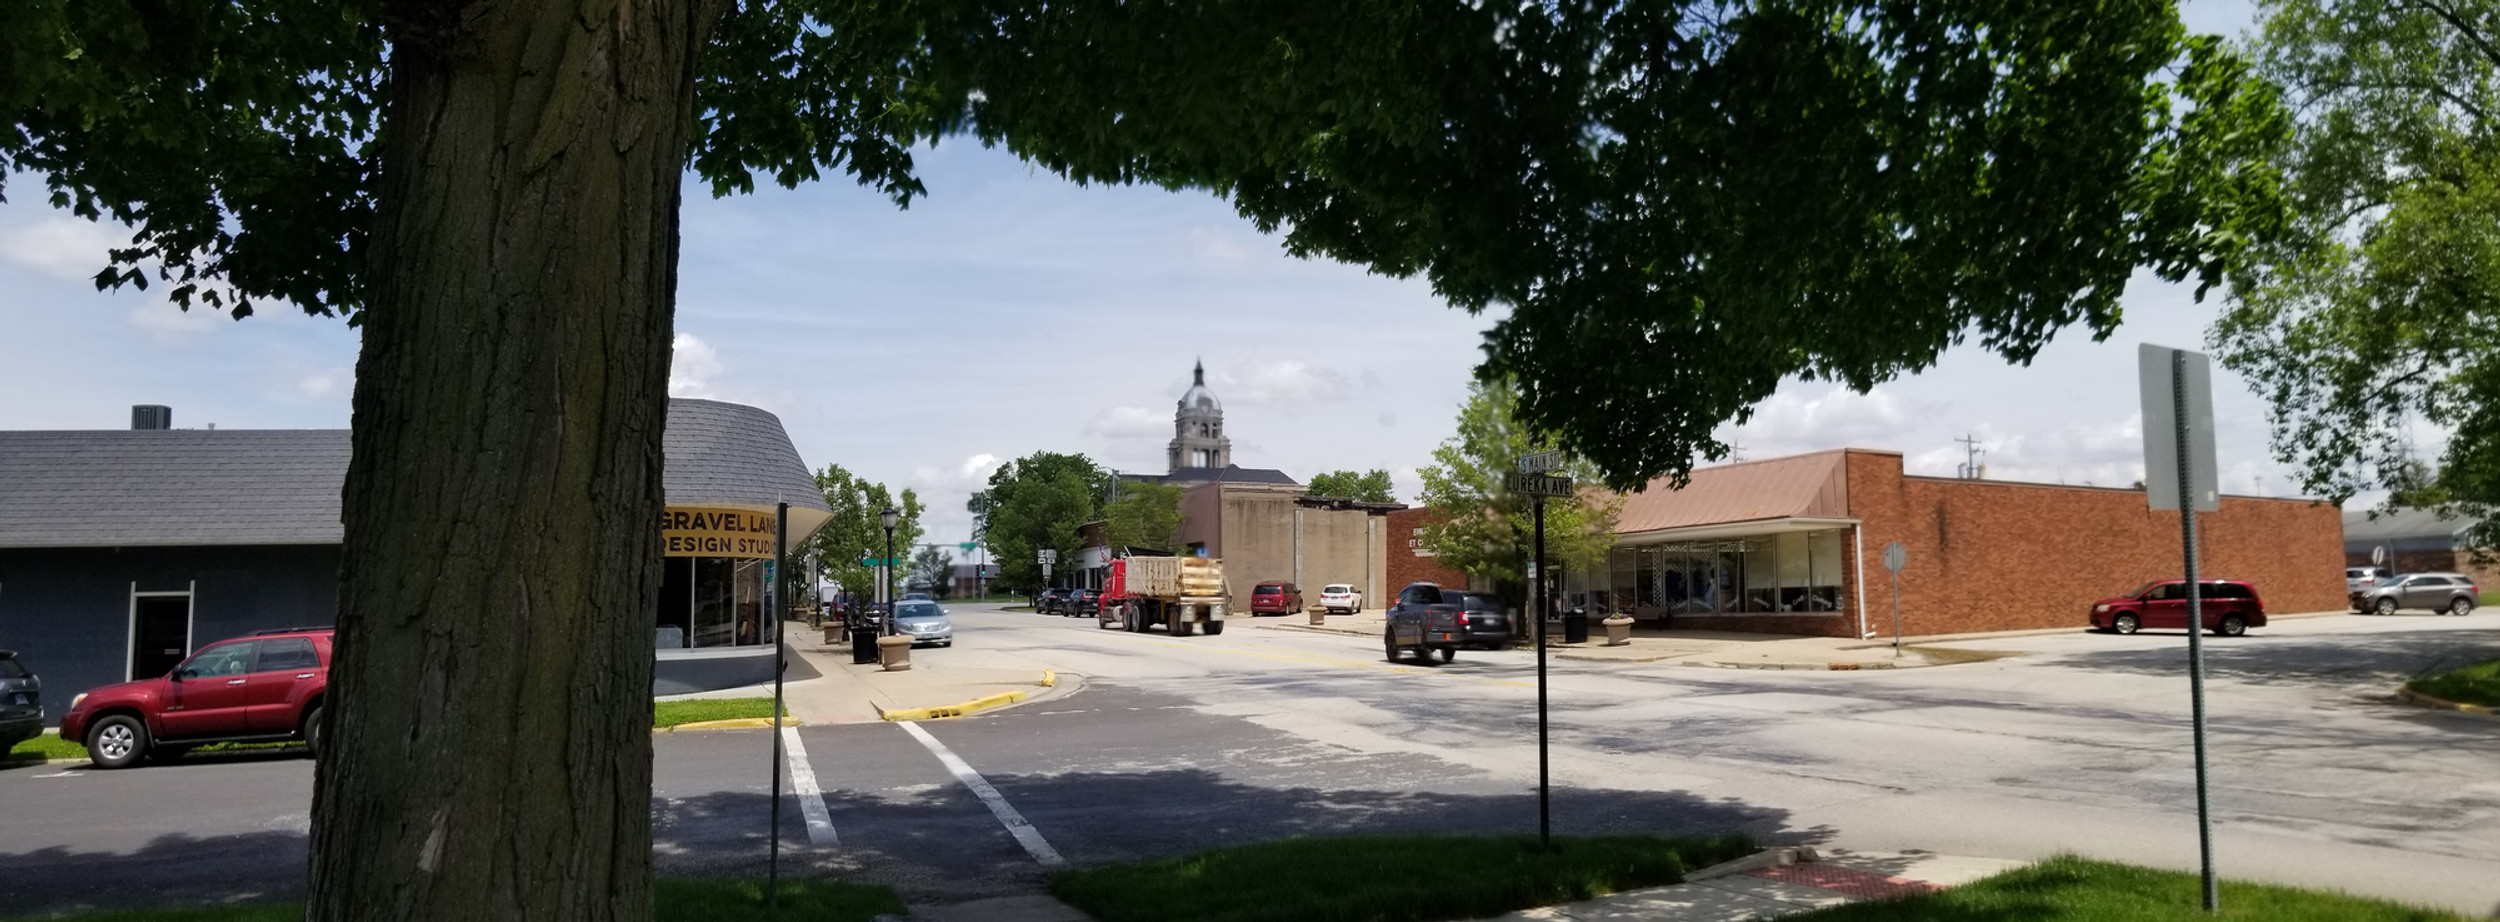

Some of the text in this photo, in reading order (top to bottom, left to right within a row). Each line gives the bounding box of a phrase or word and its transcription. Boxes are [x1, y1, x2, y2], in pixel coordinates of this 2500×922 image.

[1506, 476, 1570, 495] EUREKA AVE
[663, 536, 732, 553] ESIGN
